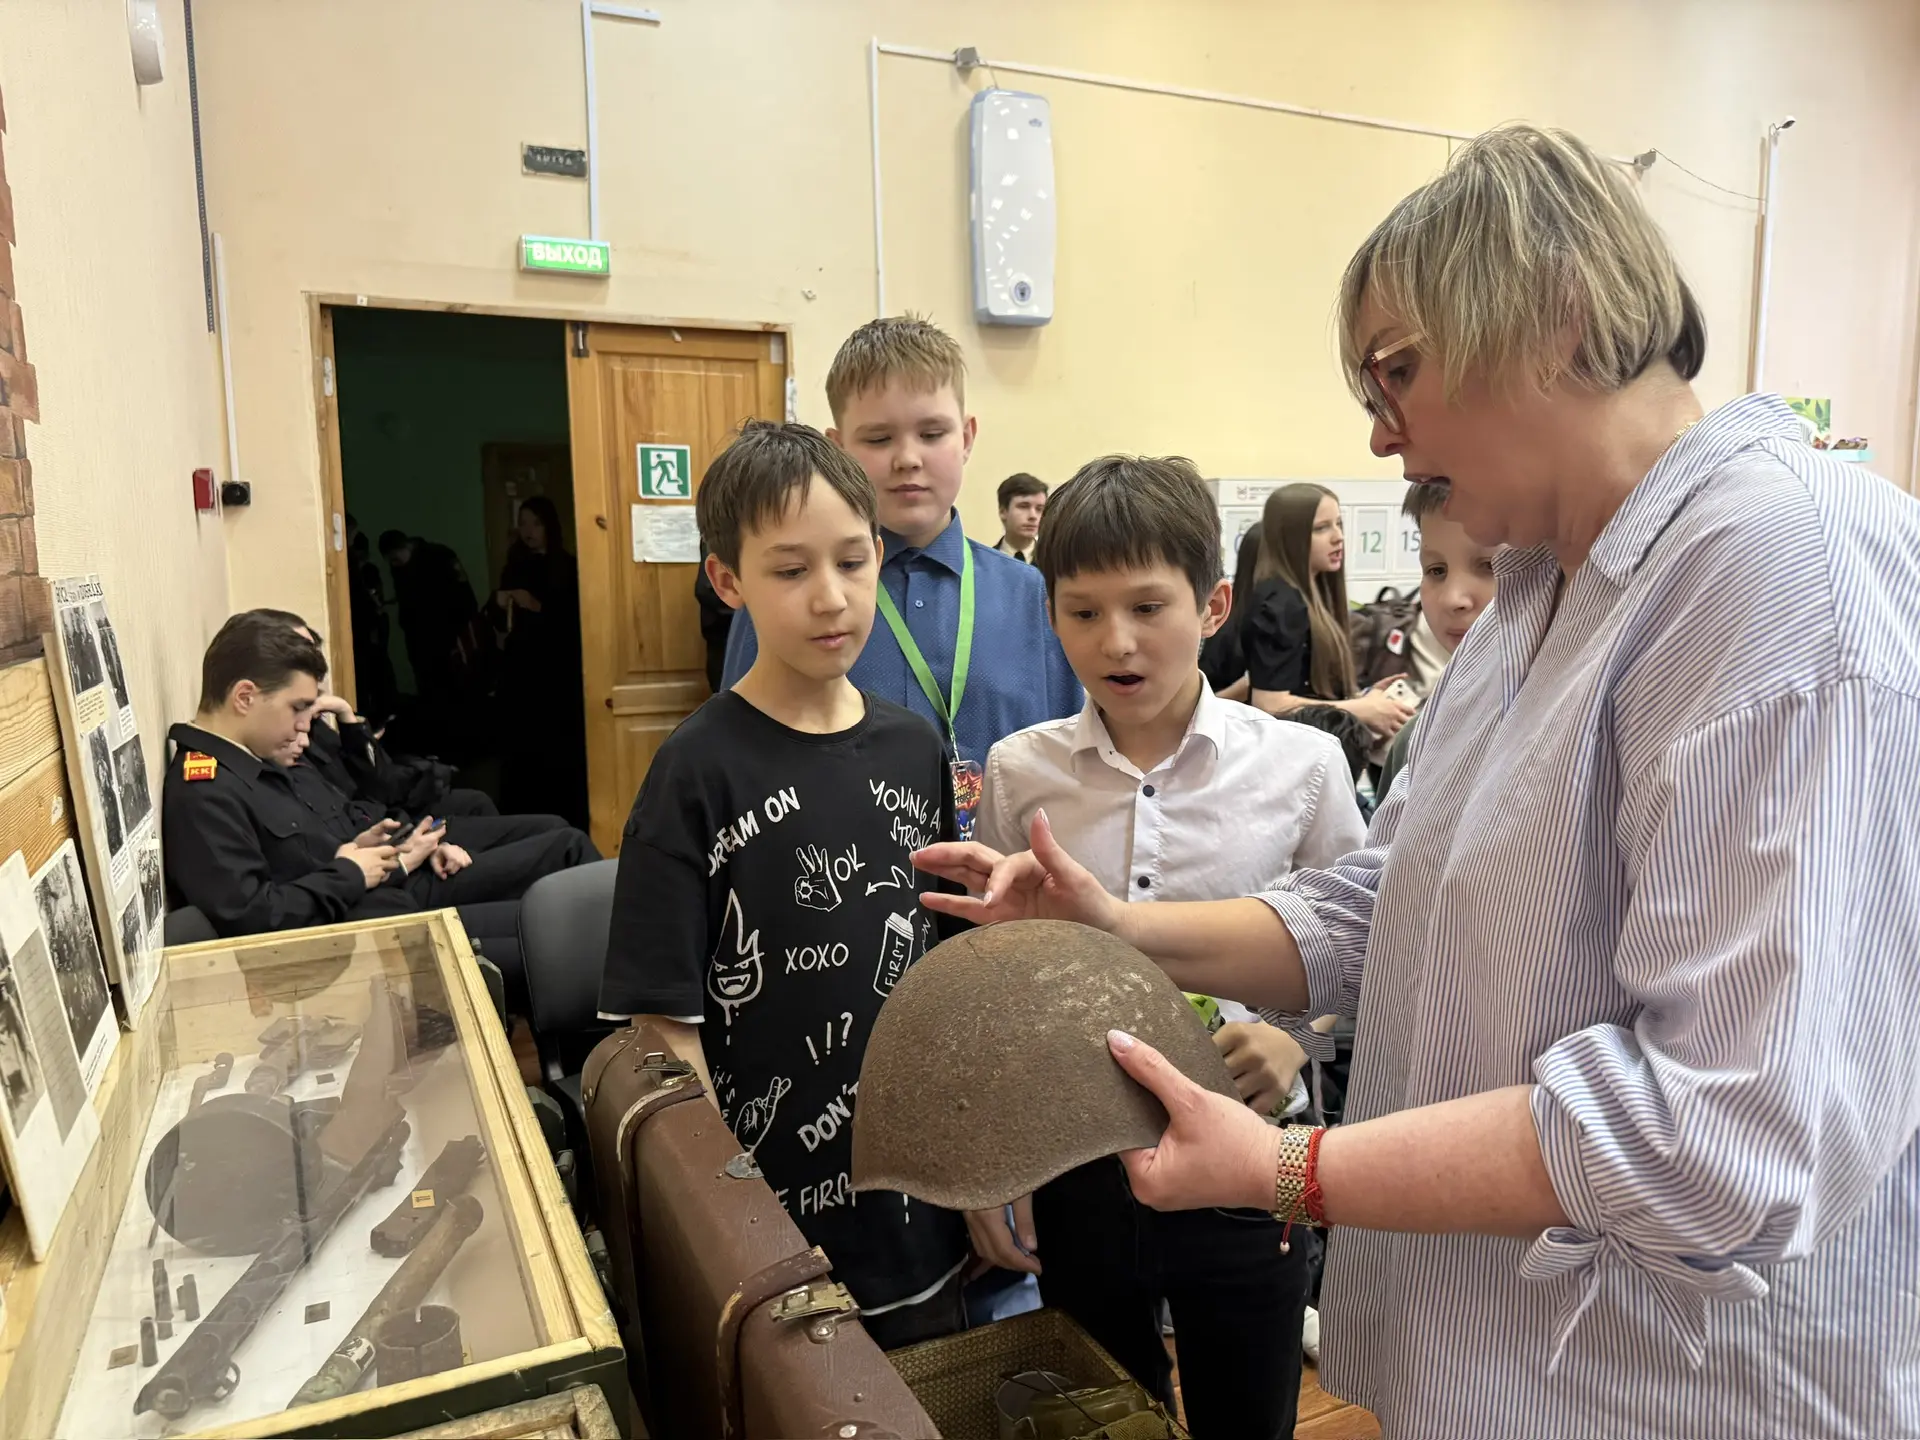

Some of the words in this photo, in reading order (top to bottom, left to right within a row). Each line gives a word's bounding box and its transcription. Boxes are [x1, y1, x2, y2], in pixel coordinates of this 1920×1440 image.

[532, 242, 603, 269] ВЫХОД
[1360, 531, 1382, 554] 12
[1401, 530, 1421, 553] 15
[764, 786, 801, 823] ON
[869, 779, 929, 825] YOUNG
[834, 843, 866, 882] OK
[785, 942, 849, 974] XOXO
[884, 935, 906, 988] FIRST
